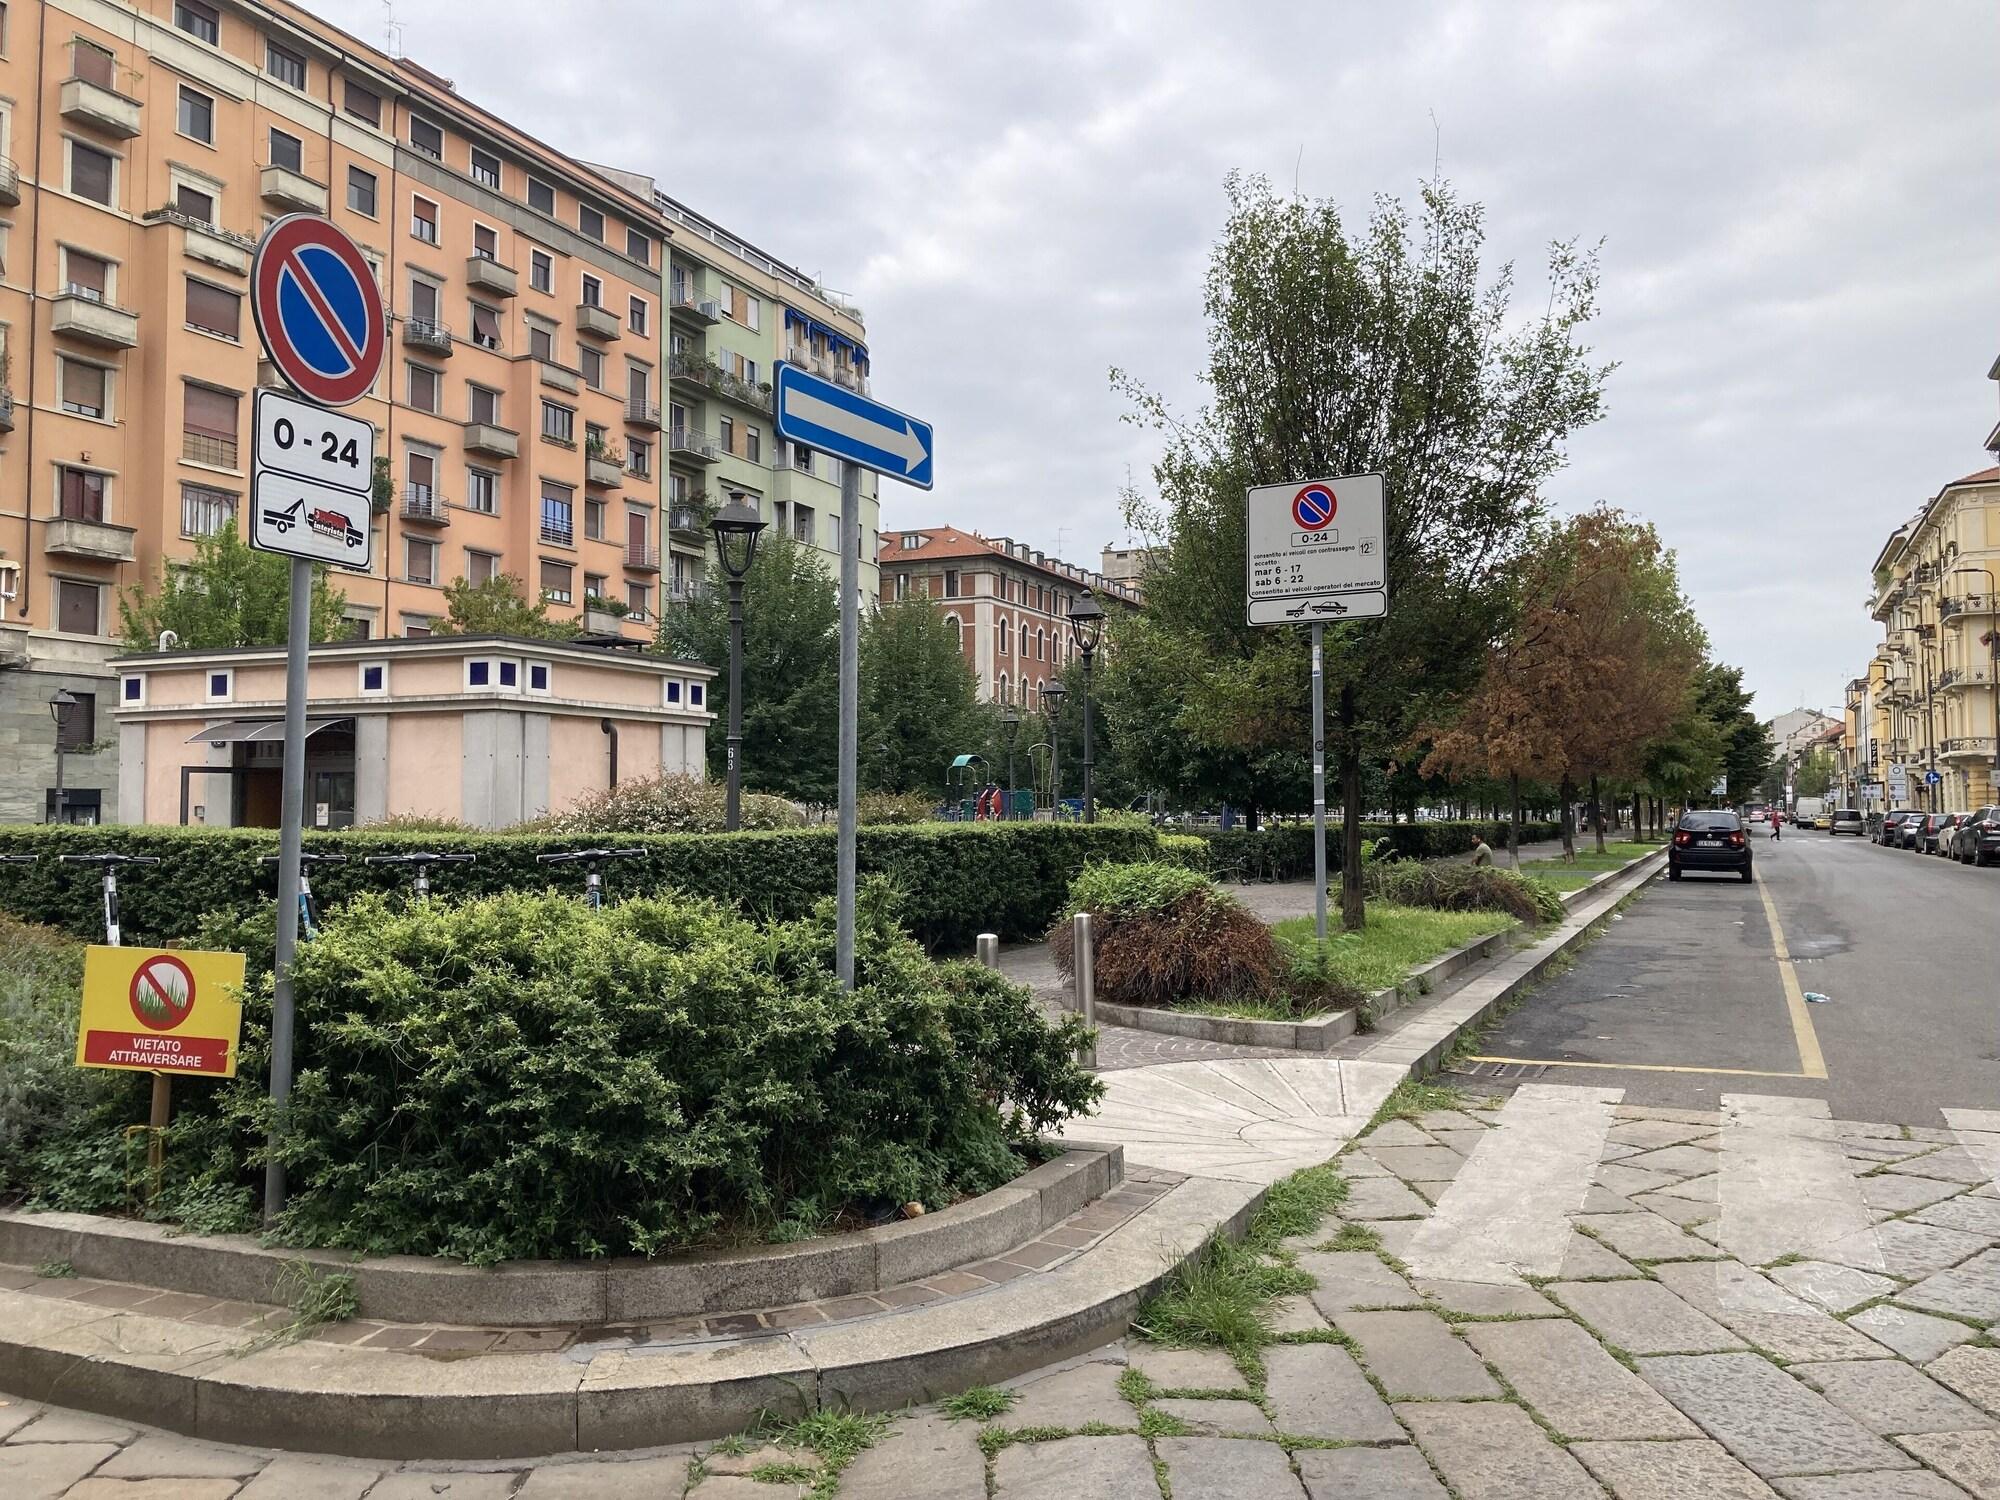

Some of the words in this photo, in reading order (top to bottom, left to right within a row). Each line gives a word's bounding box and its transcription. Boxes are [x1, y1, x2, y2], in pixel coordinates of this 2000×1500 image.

[274, 418, 294, 450] 0
[304, 438, 312, 446] -
[320, 431, 359, 468] 24
[1302, 532, 1328, 544] 0-24
[1318, 545, 1355, 553] contrassegno
[1254, 568, 1272, 576] mar
[1275, 566, 1281, 574] 6
[1290, 564, 1301, 573] 17
[1255, 578, 1271, 586] sab
[1290, 575, 1304, 583] 22
[1355, 580, 1381, 588] mercato
[132, 1038, 182, 1051] VIETATO
[108, 1050, 202, 1067] ATTRAVERSARE
